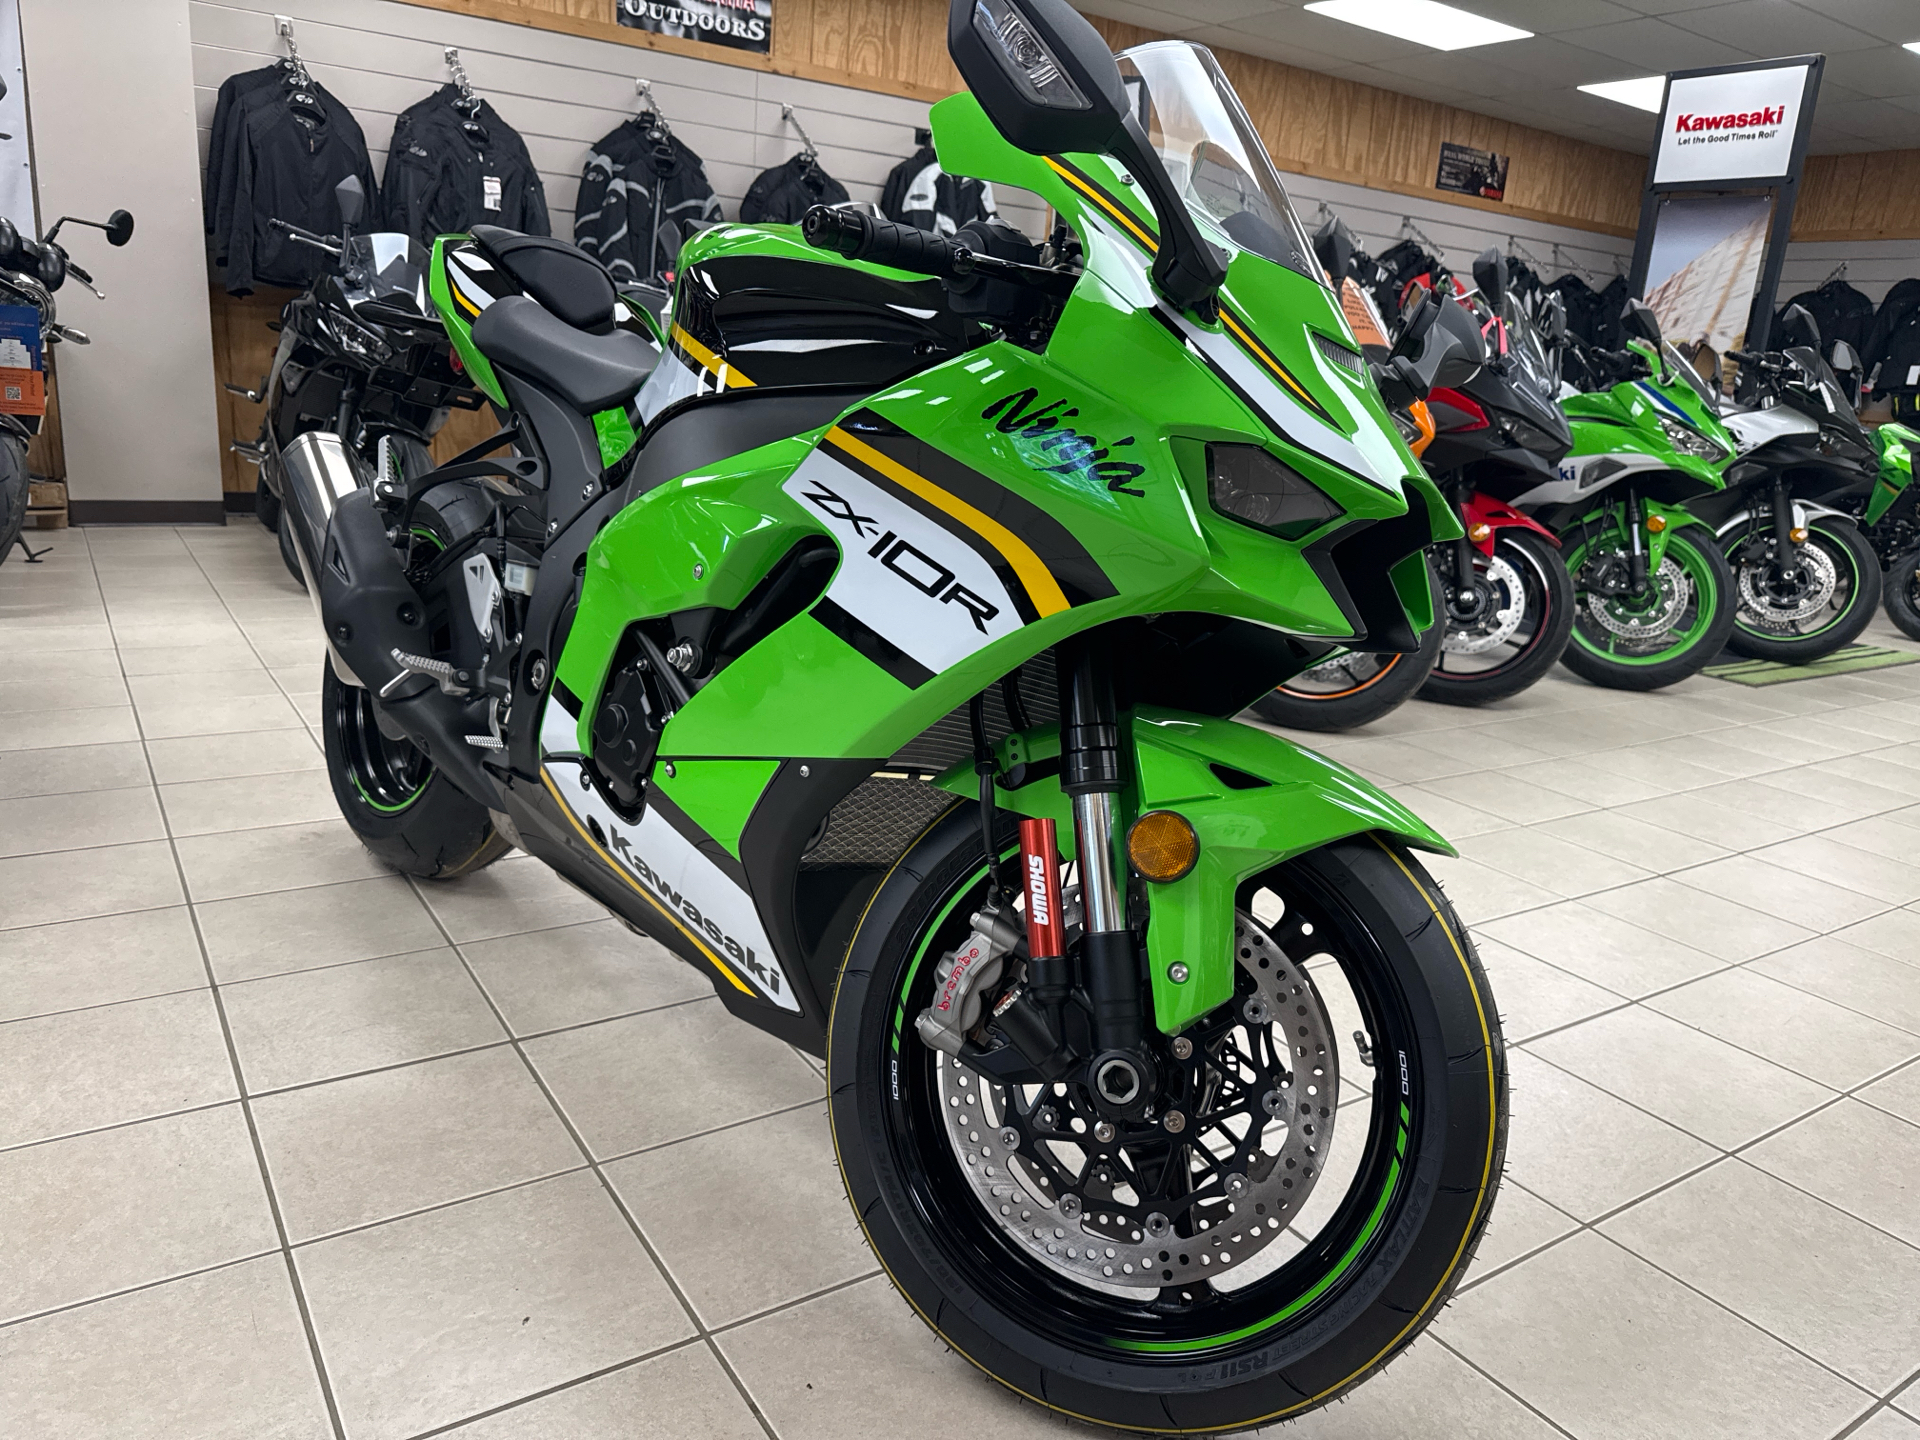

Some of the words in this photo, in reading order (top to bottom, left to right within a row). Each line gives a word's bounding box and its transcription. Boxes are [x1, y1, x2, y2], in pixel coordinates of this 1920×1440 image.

[624, 0, 766, 41] OUTDOORS
[1676, 105, 1785, 133] Kawasaki
[1678, 137, 1691, 146] Let
[1693, 136, 1706, 145] the
[1707, 133, 1730, 143] Good
[1731, 132, 1756, 141] Times
[1758, 130, 1775, 139] Roll
[981, 387, 1146, 498] Ninja
[800, 480, 999, 636] ZX-10R
[610, 823, 780, 995] Kawasaki
[1028, 853, 1049, 926] SHOWA
[937, 948, 979, 1011] brembo
[891, 1059, 899, 1101] 1000
[1398, 1049, 1409, 1096] 1000
